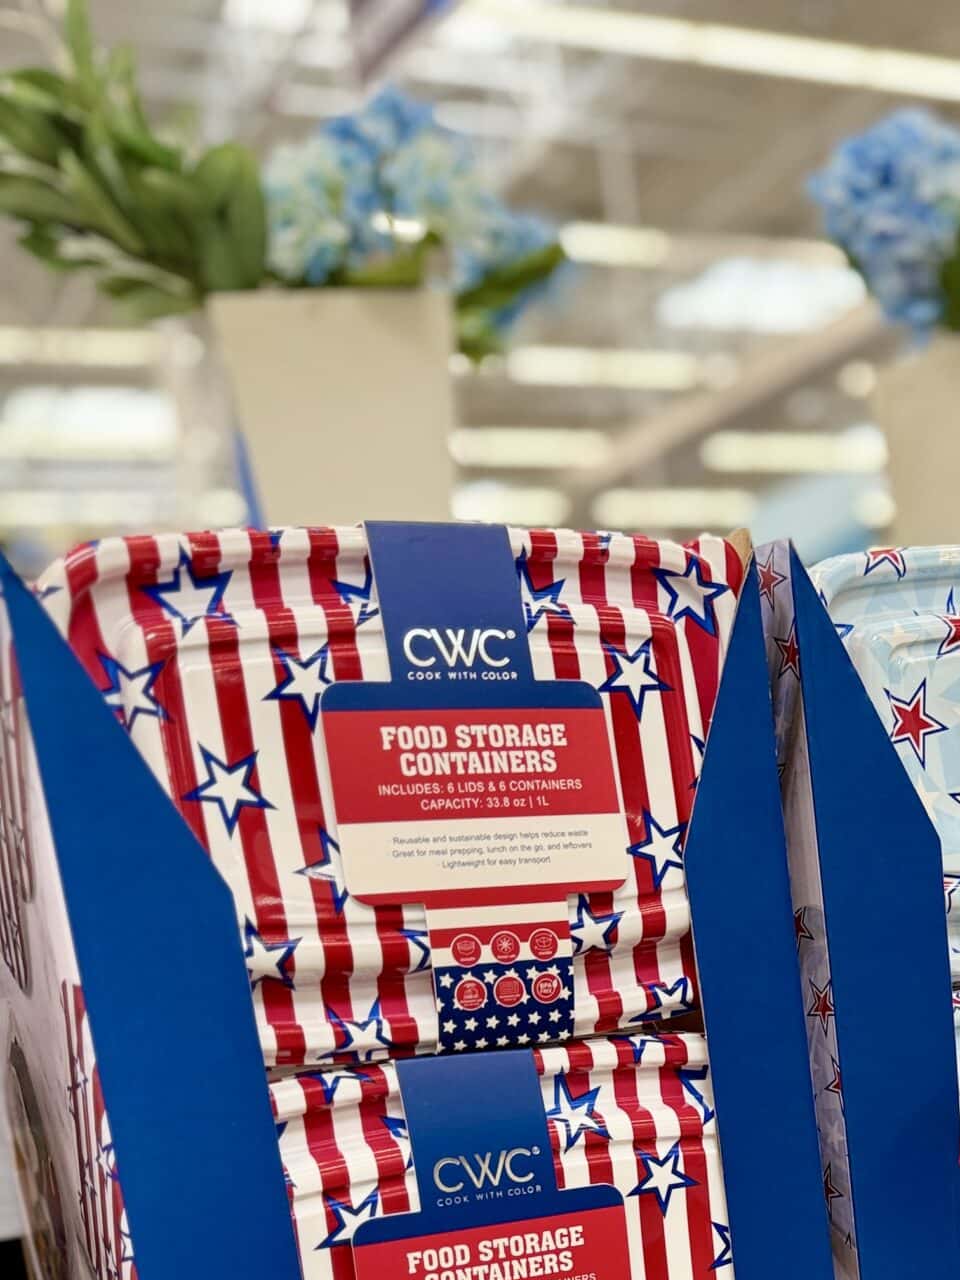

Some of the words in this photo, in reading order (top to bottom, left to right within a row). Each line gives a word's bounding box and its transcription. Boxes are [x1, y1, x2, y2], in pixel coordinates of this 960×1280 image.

[407, 672, 441, 681] COOK
[448, 671, 477, 680] WITH
[481, 671, 518, 680] COLOR
[380, 726, 447, 750] FOOD
[455, 723, 568, 749] STORAGE
[400, 749, 557, 776] CONTAINERS
[378, 783, 444, 796] INCLUDES:
[447, 783, 455, 793] 6
[458, 782, 484, 793] LIDS
[488, 781, 496, 792] &
[499, 781, 506, 792] 6
[509, 779, 582, 792] CONTAINERS
[421, 799, 483, 811] CAPACITY:
[486, 797, 510, 808] 33.8
[514, 799, 527, 807] oz
[537, 796, 549, 807] 1L
[393, 836, 430, 845] Reusable
[432, 834, 446, 844] and
[448, 832, 491, 843] sustainable
[493, 831, 518, 841] design
[520, 830, 540, 840] helps
[541, 829, 565, 838] reduce
[567, 829, 588, 837] waste
[392, 849, 415, 858] Great
[416, 848, 427, 857] for
[429, 847, 448, 856] meal
[450, 845, 484, 857] prepping,
[486, 844, 508, 854] lunch
[509, 845, 518, 853] on
[519, 843, 532, 851] the
[548, 841, 561, 851] and
[563, 841, 592, 850] leftovers
[442, 857, 485, 869] Lightweight
[487, 857, 497, 866] for
[499, 857, 517, 867] easy
[518, 855, 550, 867] transport
[437, 1196, 469, 1207] COOK
[476, 1191, 503, 1201] WITH
[507, 1185, 542, 1197] COLOR
[406, 1245, 470, 1274] FOOD
[478, 1225, 584, 1262] STORAGE
